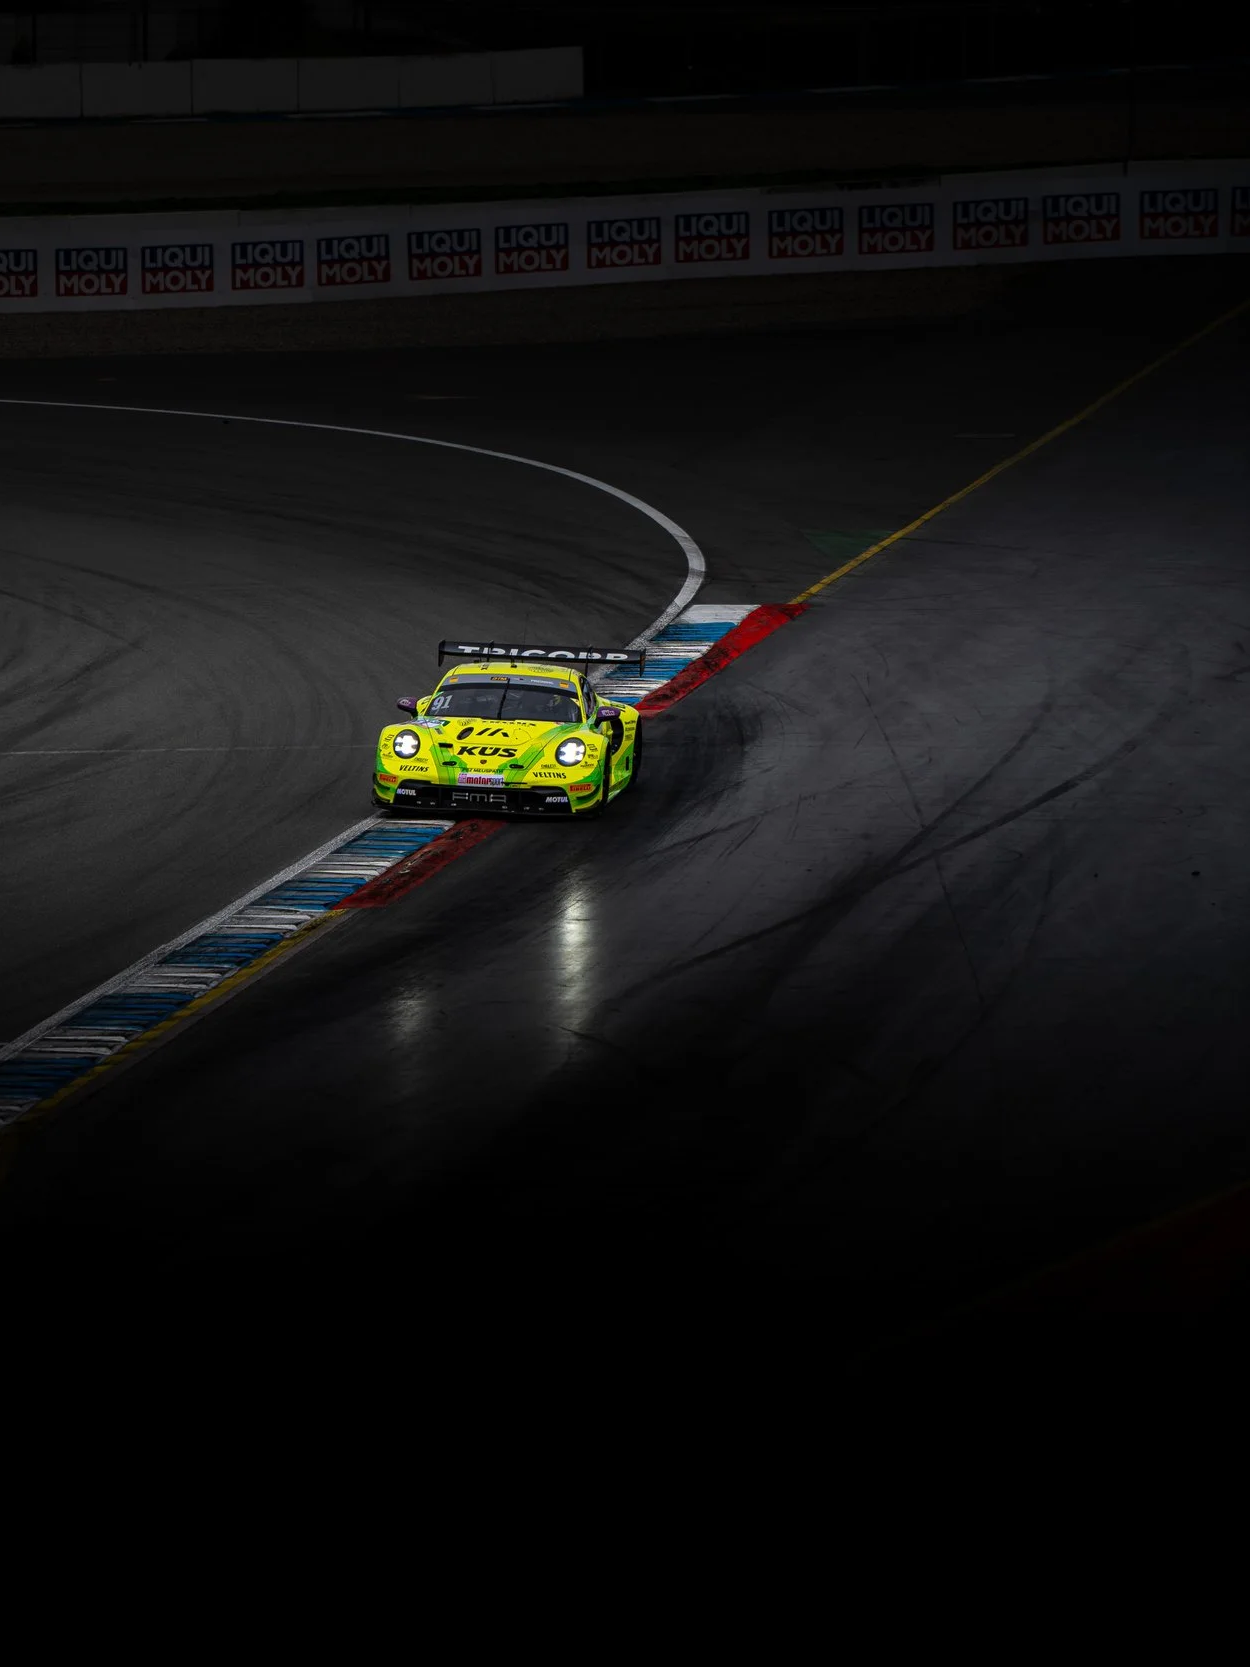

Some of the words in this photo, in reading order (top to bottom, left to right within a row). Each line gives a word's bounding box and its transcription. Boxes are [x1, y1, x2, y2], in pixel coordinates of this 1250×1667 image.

[957, 199, 1026, 224] LIQUI
[1046, 194, 1118, 219] LIQUI
[1143, 191, 1216, 215] LIQUI
[677, 213, 748, 239] LIQUI
[771, 209, 842, 235] LIQUI
[861, 205, 932, 231] LIQUI
[1143, 215, 1217, 238] MOLY
[410, 230, 480, 255] LIQUI
[497, 225, 567, 251] LIQUI
[590, 219, 660, 244] LIQUI
[861, 229, 933, 254] MOLY
[957, 223, 1027, 249] MOLY
[1046, 218, 1119, 244] MOLY
[144, 246, 212, 270] LIQUI
[234, 242, 302, 266] LIQUI
[320, 236, 390, 261] LIQUI
[590, 242, 661, 267] MOLY
[677, 237, 749, 262] MOLY
[771, 233, 843, 258] MOLY
[58, 249, 126, 273] LIQUI
[320, 260, 391, 286] MOLY
[410, 254, 481, 280] MOLY
[497, 249, 568, 274] MOLY
[58, 273, 127, 296] MOLY
[144, 270, 213, 293] MOLY
[234, 266, 303, 289] MOLY
[431, 694, 453, 711] 91
[457, 745, 518, 758] KÜS
[399, 764, 430, 772] VELTINS
[532, 771, 567, 779] VELTINS
[396, 788, 417, 796] MOTUL
